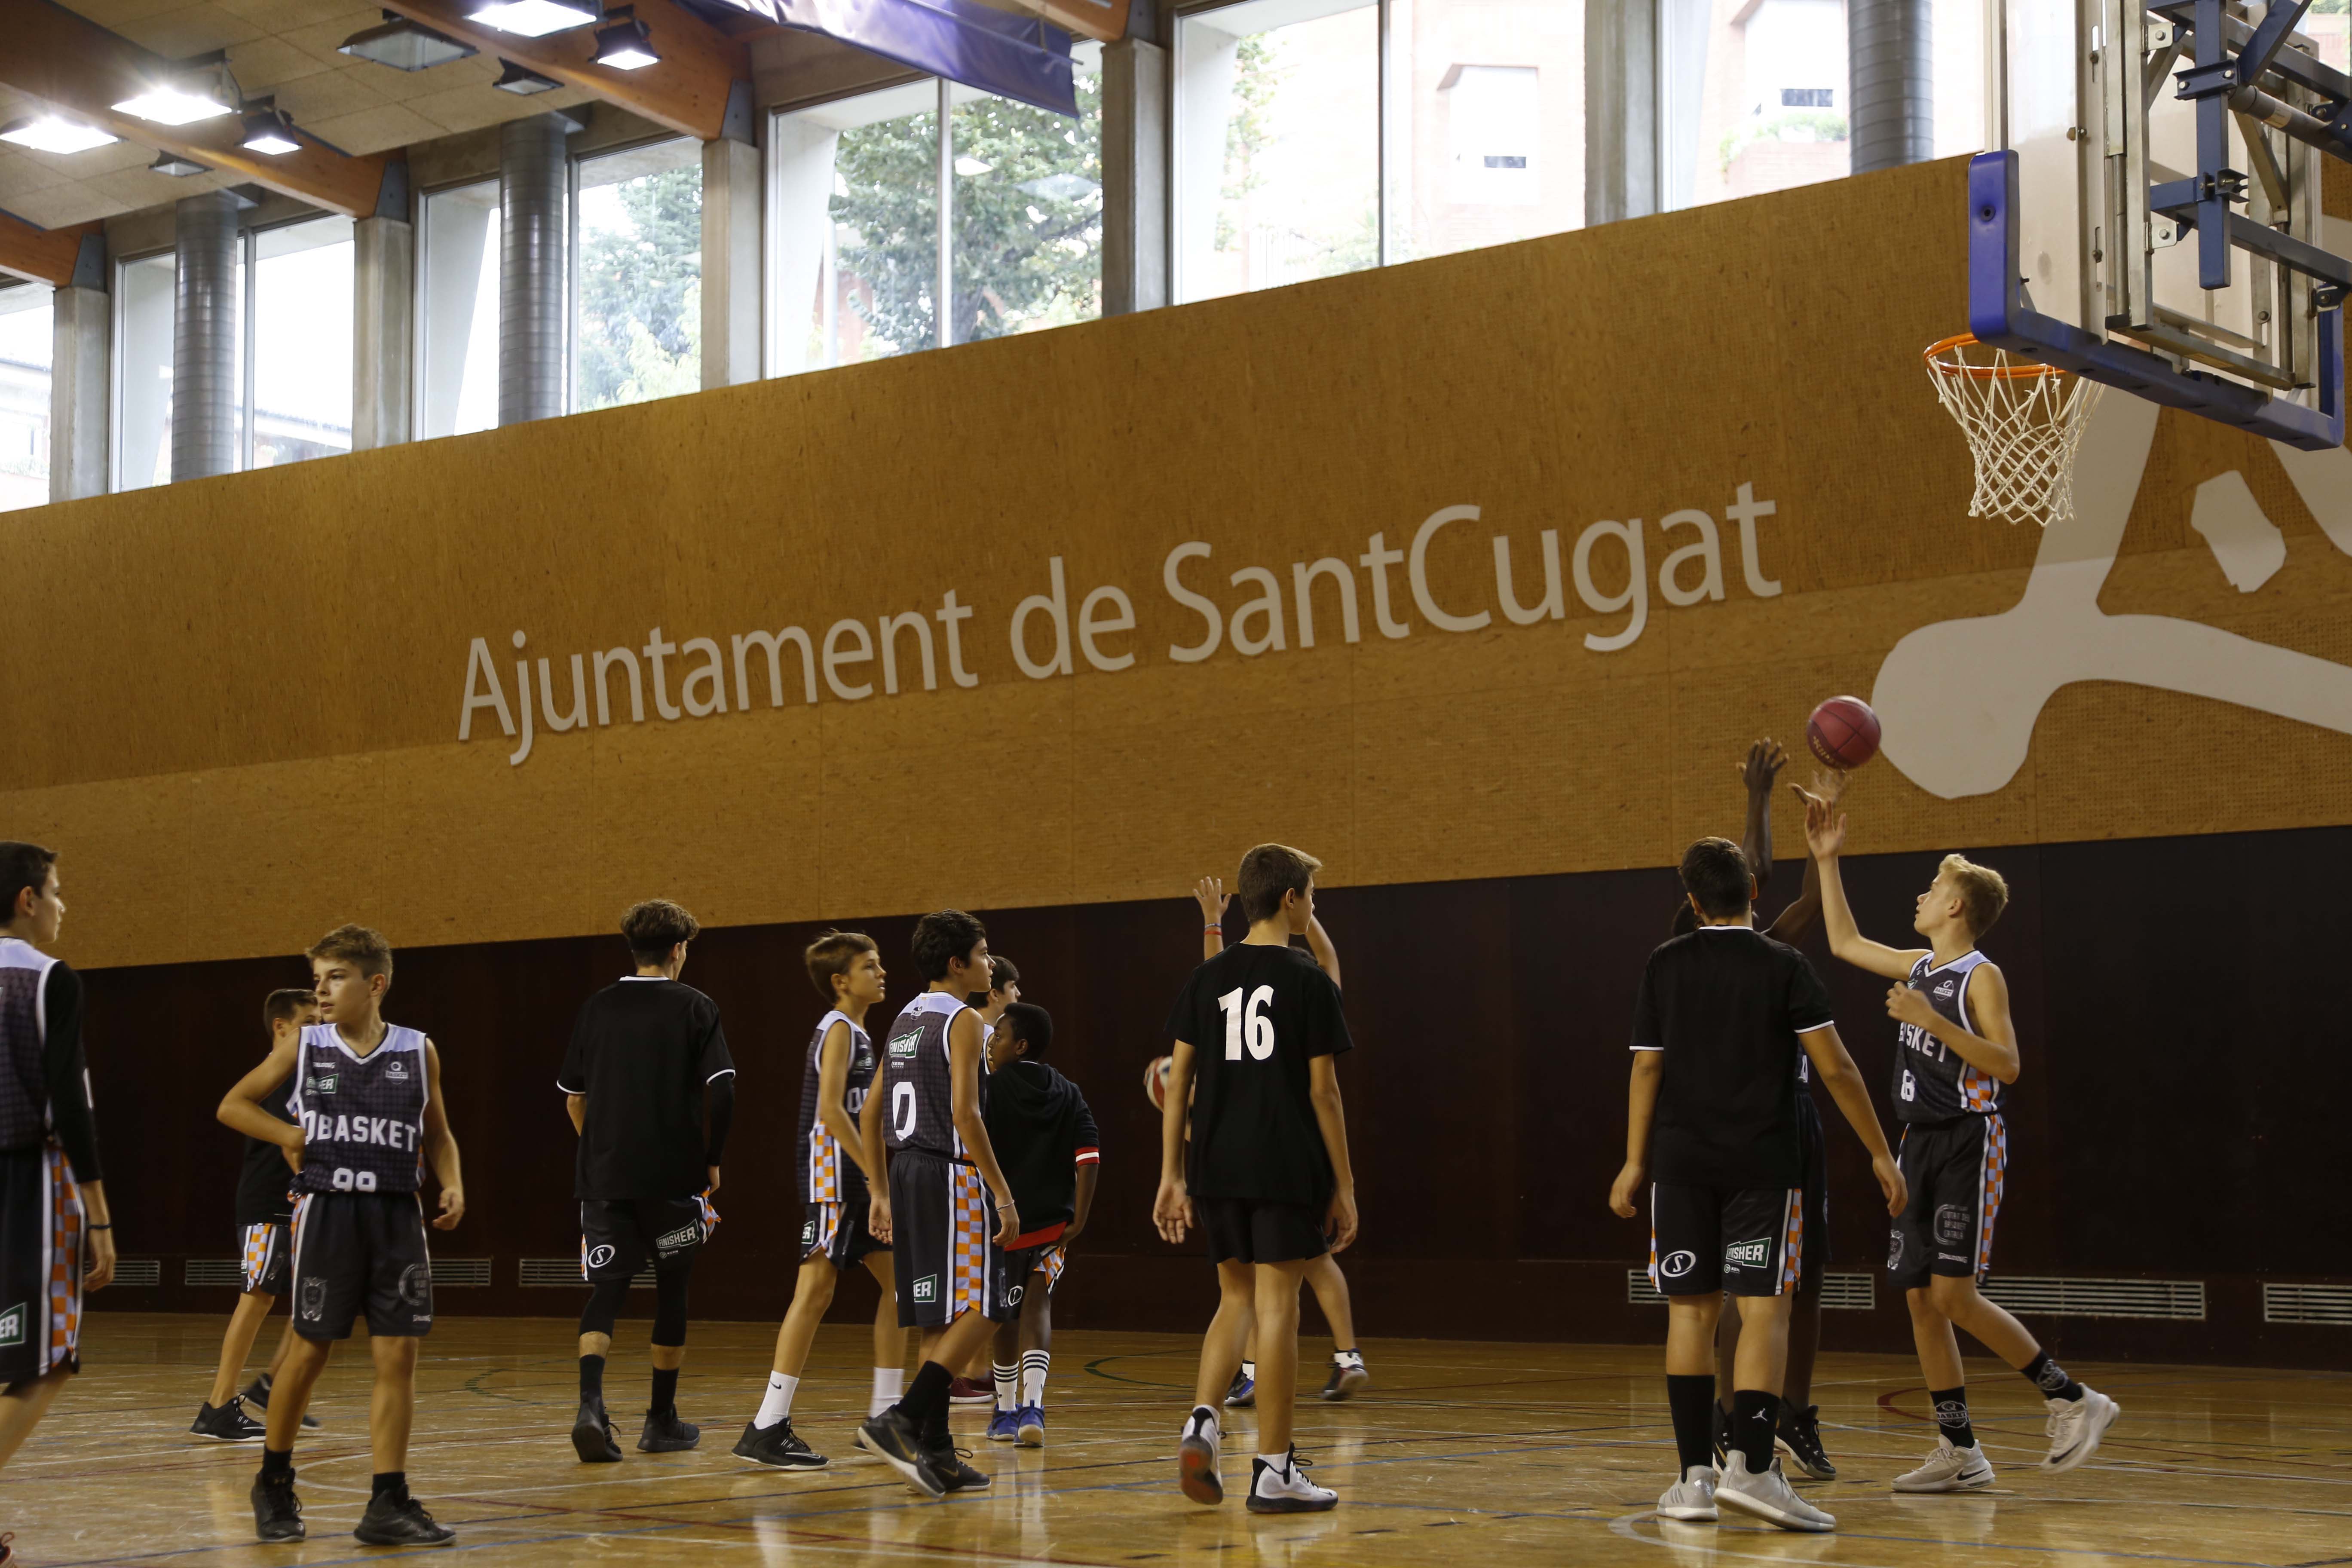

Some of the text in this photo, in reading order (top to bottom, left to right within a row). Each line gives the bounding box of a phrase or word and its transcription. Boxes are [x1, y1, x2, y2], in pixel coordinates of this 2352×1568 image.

[458, 481, 1782, 766] Ajuntament de SantCugat
[1218, 985, 1274, 1060] 16
[658, 1226, 695, 1246] FINISHER
